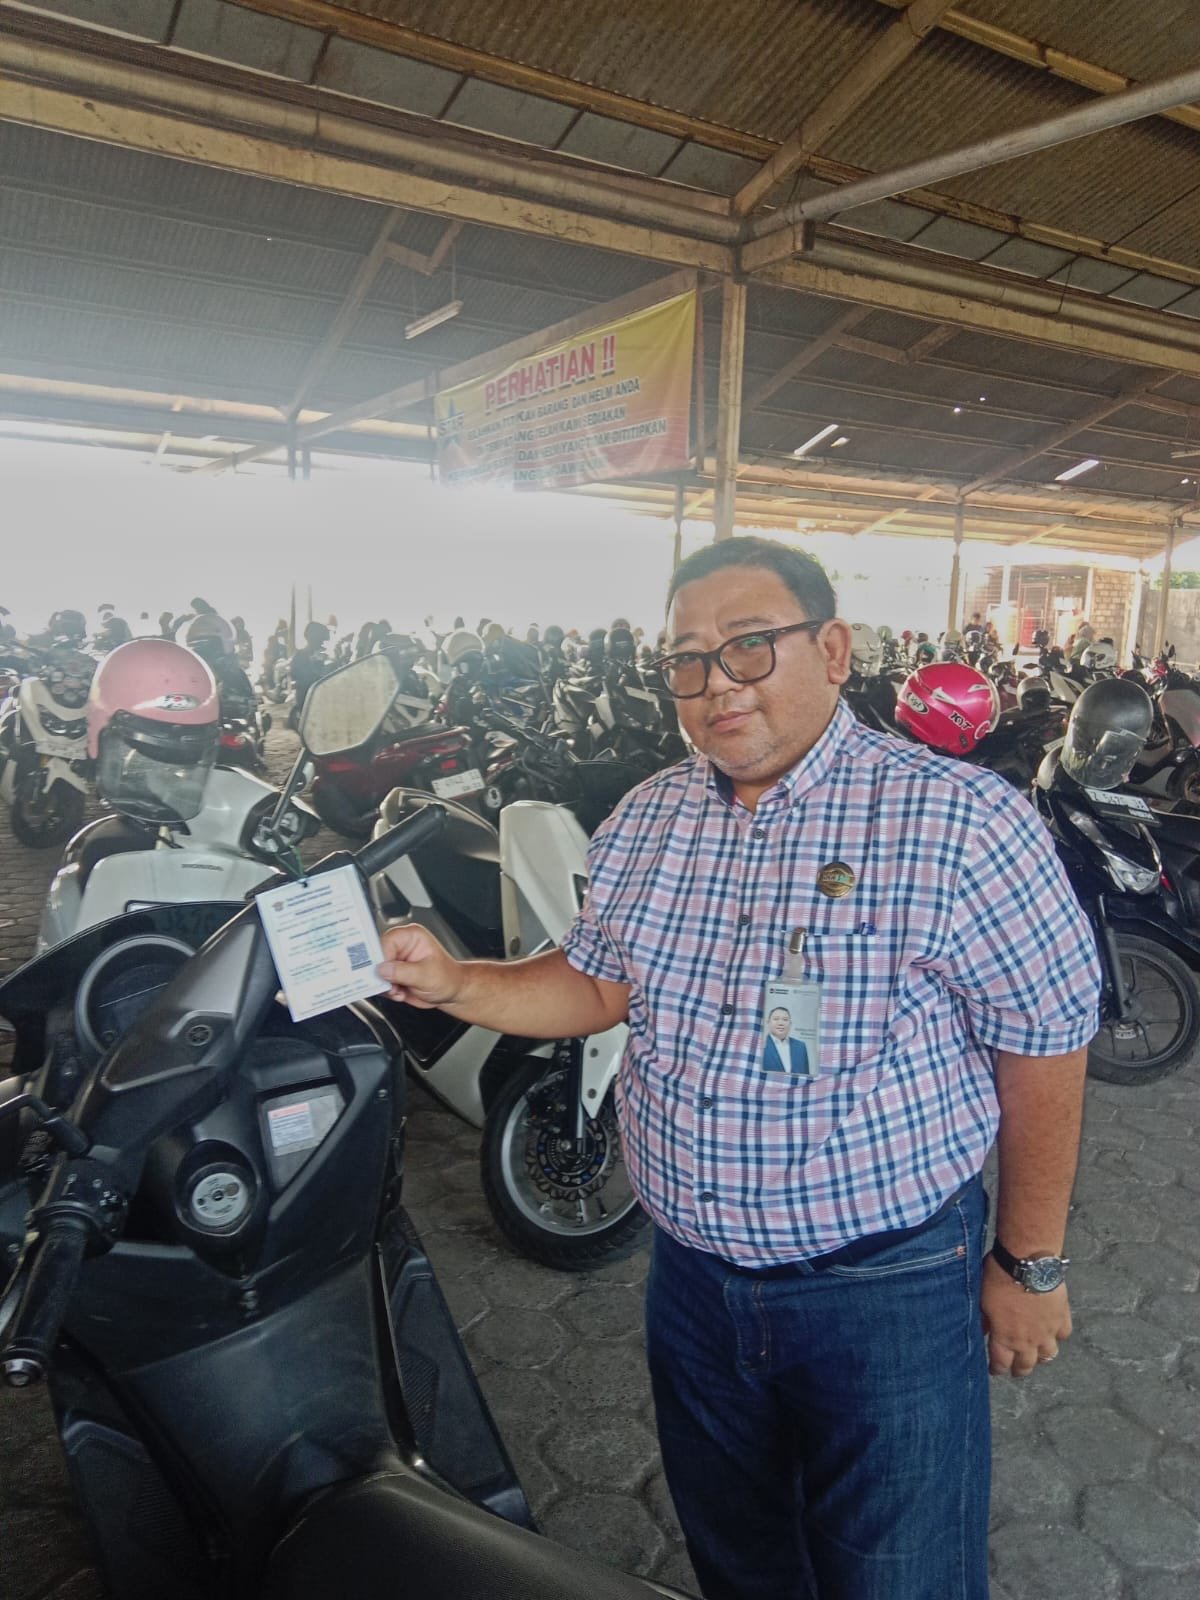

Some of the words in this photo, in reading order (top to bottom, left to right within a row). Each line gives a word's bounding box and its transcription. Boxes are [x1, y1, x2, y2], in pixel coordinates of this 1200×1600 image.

[485, 342, 595, 410] PERHATIAN
[602, 335, 615, 370] !!
[615, 377, 640, 396] ANDA
